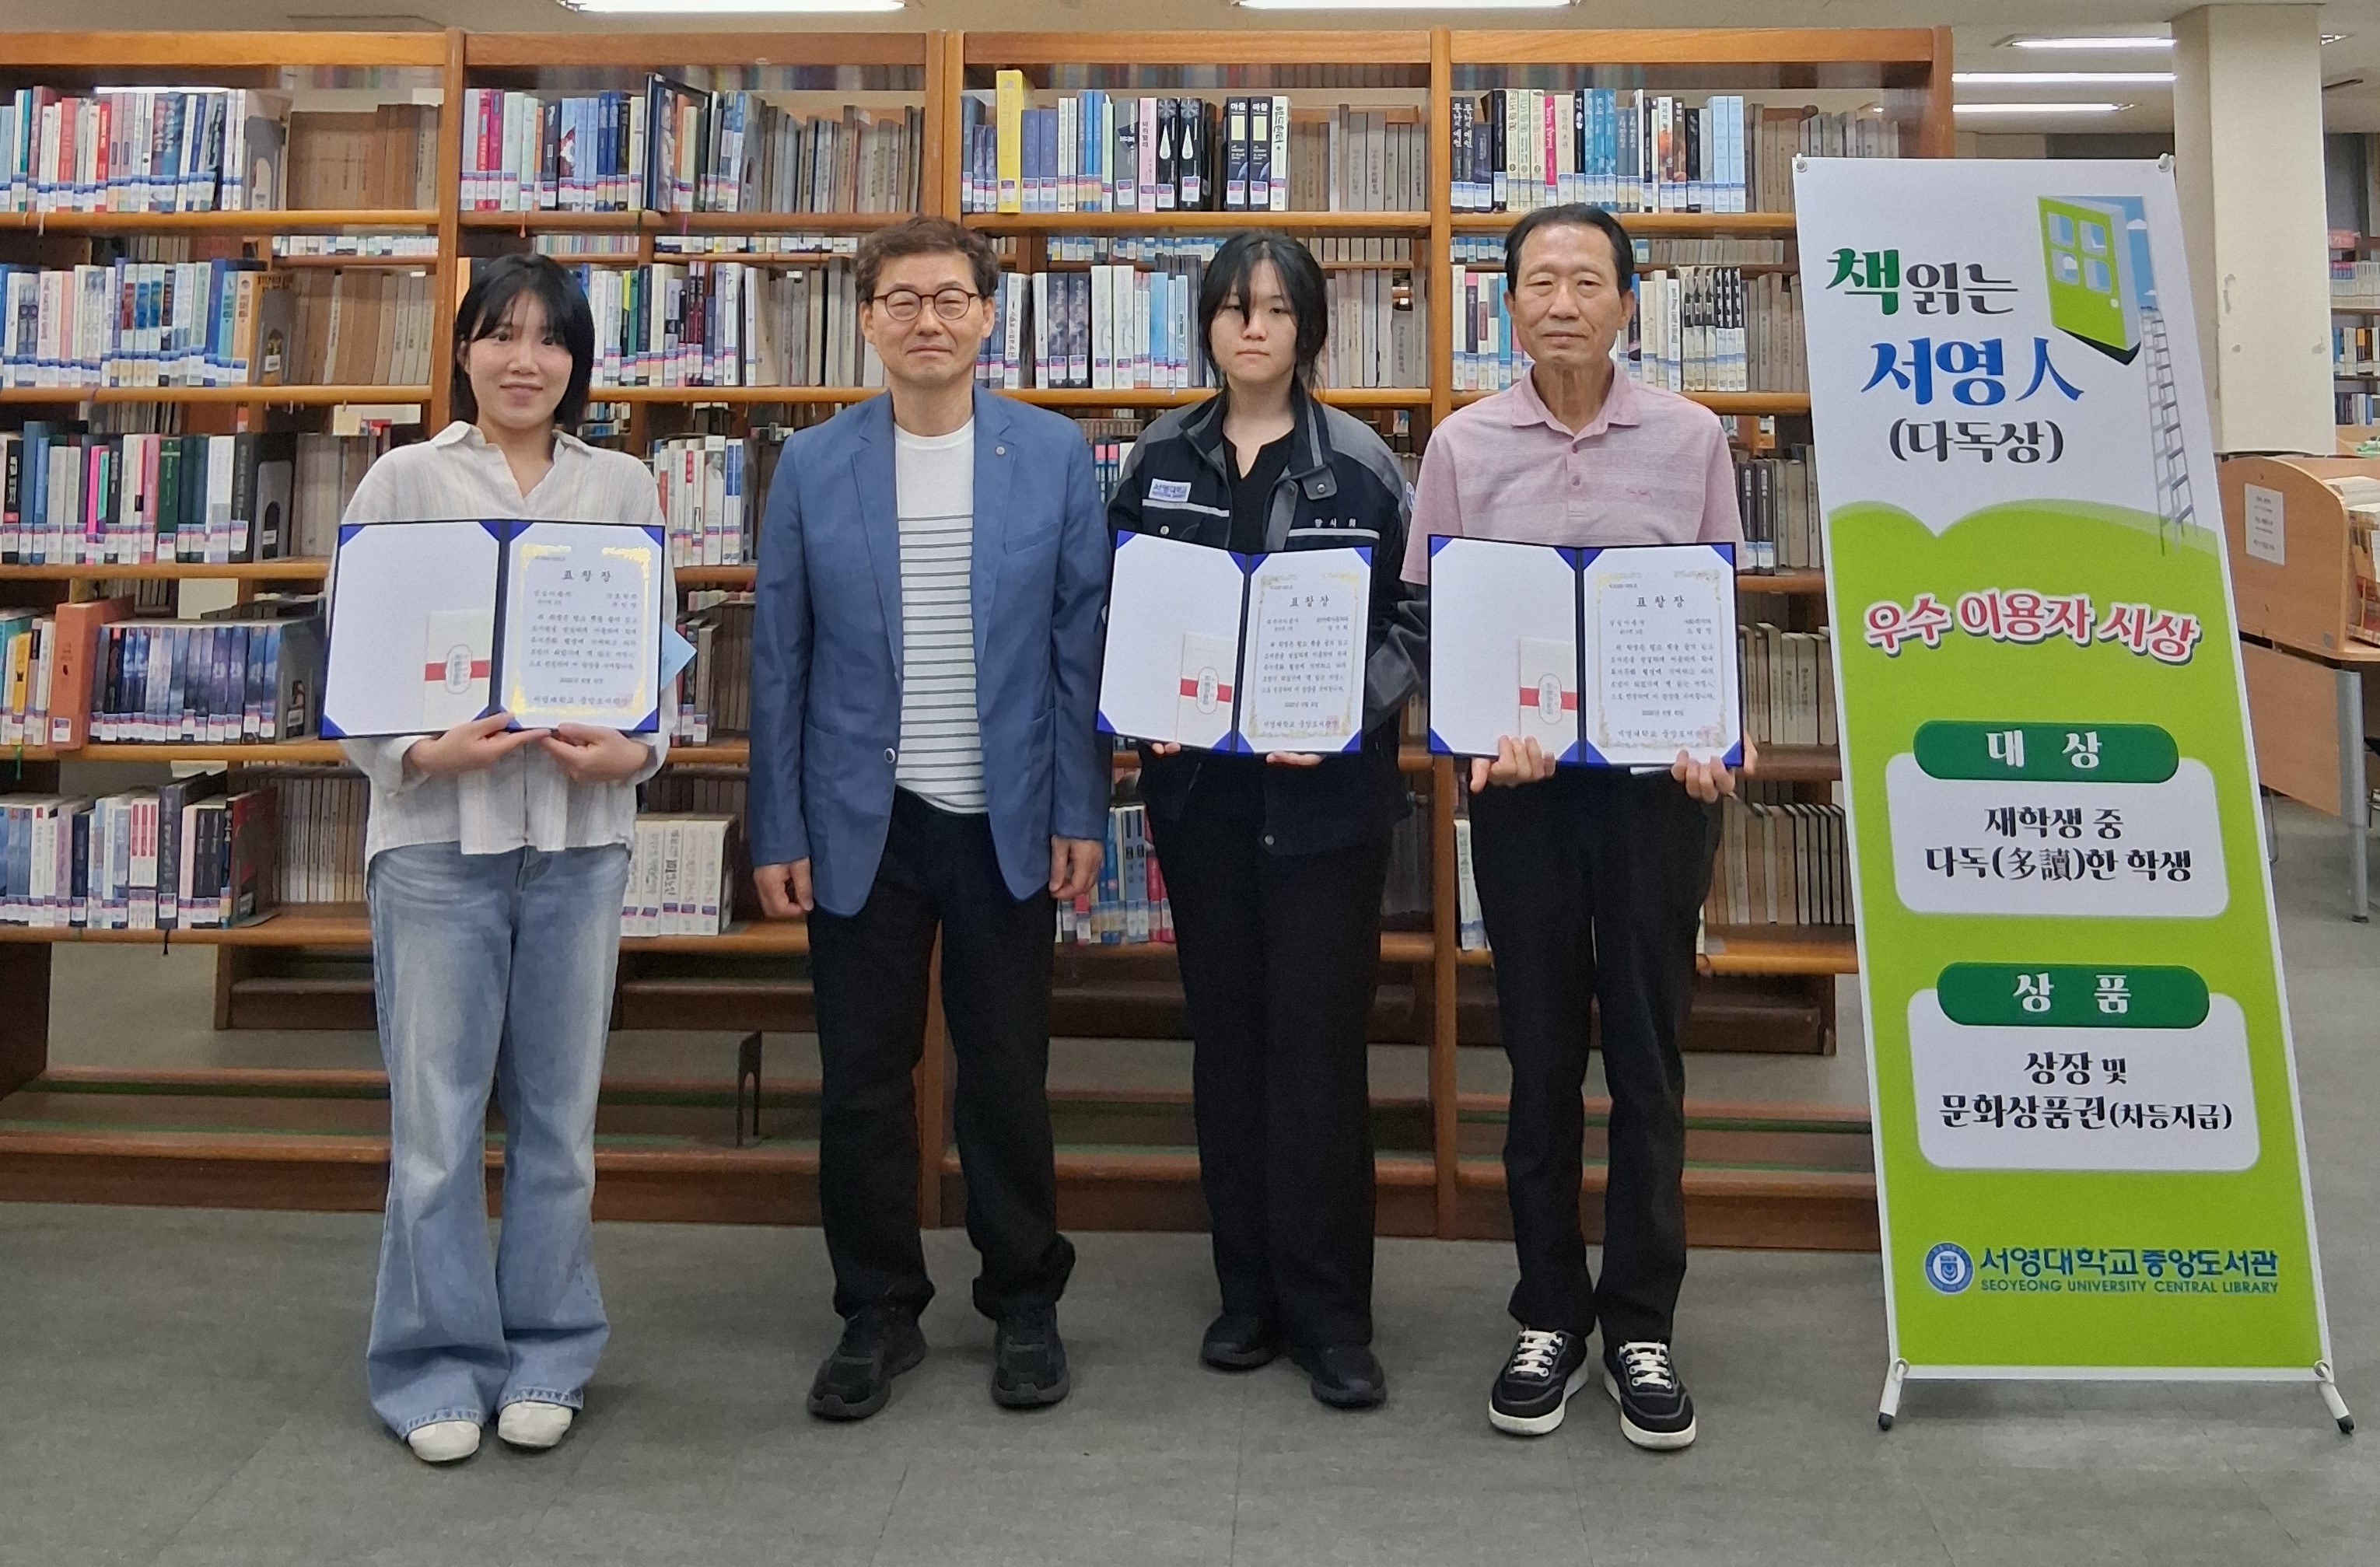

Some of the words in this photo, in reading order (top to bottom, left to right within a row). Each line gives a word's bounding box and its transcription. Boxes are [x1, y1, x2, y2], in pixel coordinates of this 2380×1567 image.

[1825, 248, 2018, 316] 책읽는
[1860, 337, 2085, 407] 서영人
[1889, 418, 2065, 464] (다독상)
[1864, 594, 1951, 656] 우수
[1958, 589, 2094, 645] 이용자
[2098, 603, 2200, 661] 시상
[1984, 806, 2083, 840] 재학생
[2092, 808, 2124, 840] 중
[1925, 847, 2119, 882] 다독(多讀)한
[2126, 849, 2192, 883] 학생
[2024, 1051, 2091, 1086] 상장
[2102, 1056, 2127, 1086] 및
[1939, 1094, 2233, 1131] 문화상품권(차등지급)
[1981, 1278, 2062, 1292] SEOYEONG
[2067, 1279, 2147, 1292] UNIVERSITY
[2154, 1279, 2218, 1293] CENTRAL
[2222, 1280, 2279, 1293] LIBRARY
